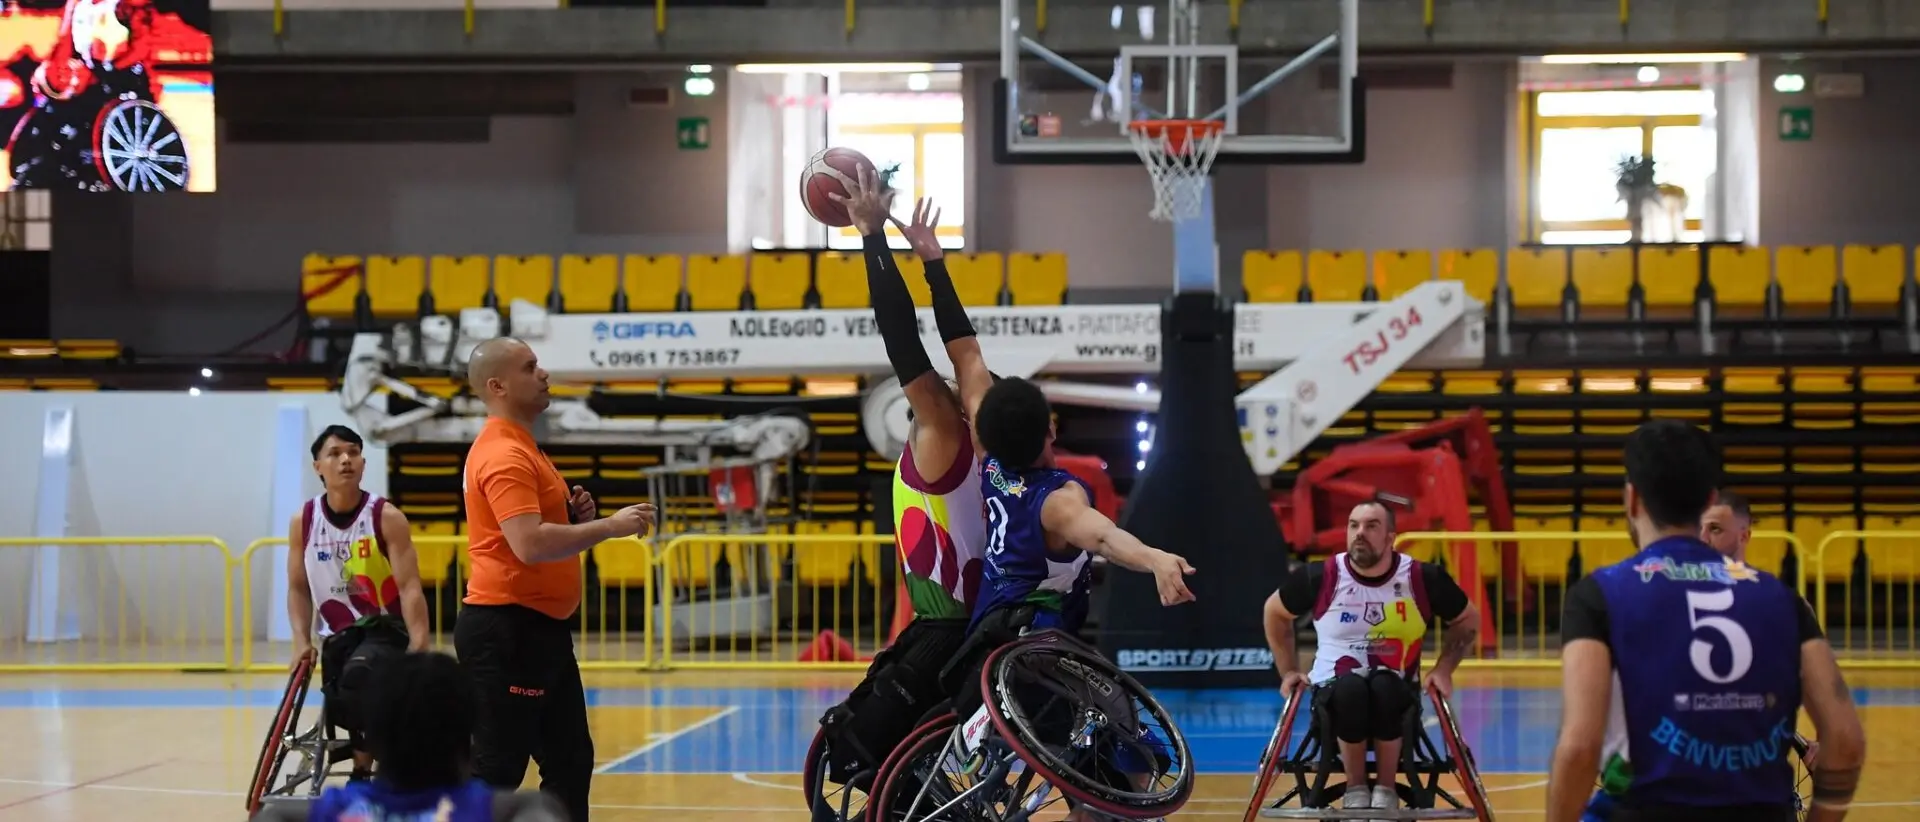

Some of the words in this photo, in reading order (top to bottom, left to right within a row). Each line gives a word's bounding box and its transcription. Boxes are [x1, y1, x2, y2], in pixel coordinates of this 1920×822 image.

[612, 322, 697, 339] GIFRA
[730, 318, 827, 337] NOLEGGIO
[970, 315, 1062, 336] SISTENZA
[1079, 313, 1160, 335] PIATTAFO
[1343, 330, 1389, 374] TSJ
[1388, 306, 1422, 341] 34
[608, 350, 657, 366] 0961
[665, 348, 741, 366] 753867
[1396, 601, 1407, 622] 9
[1686, 588, 1753, 684] 5
